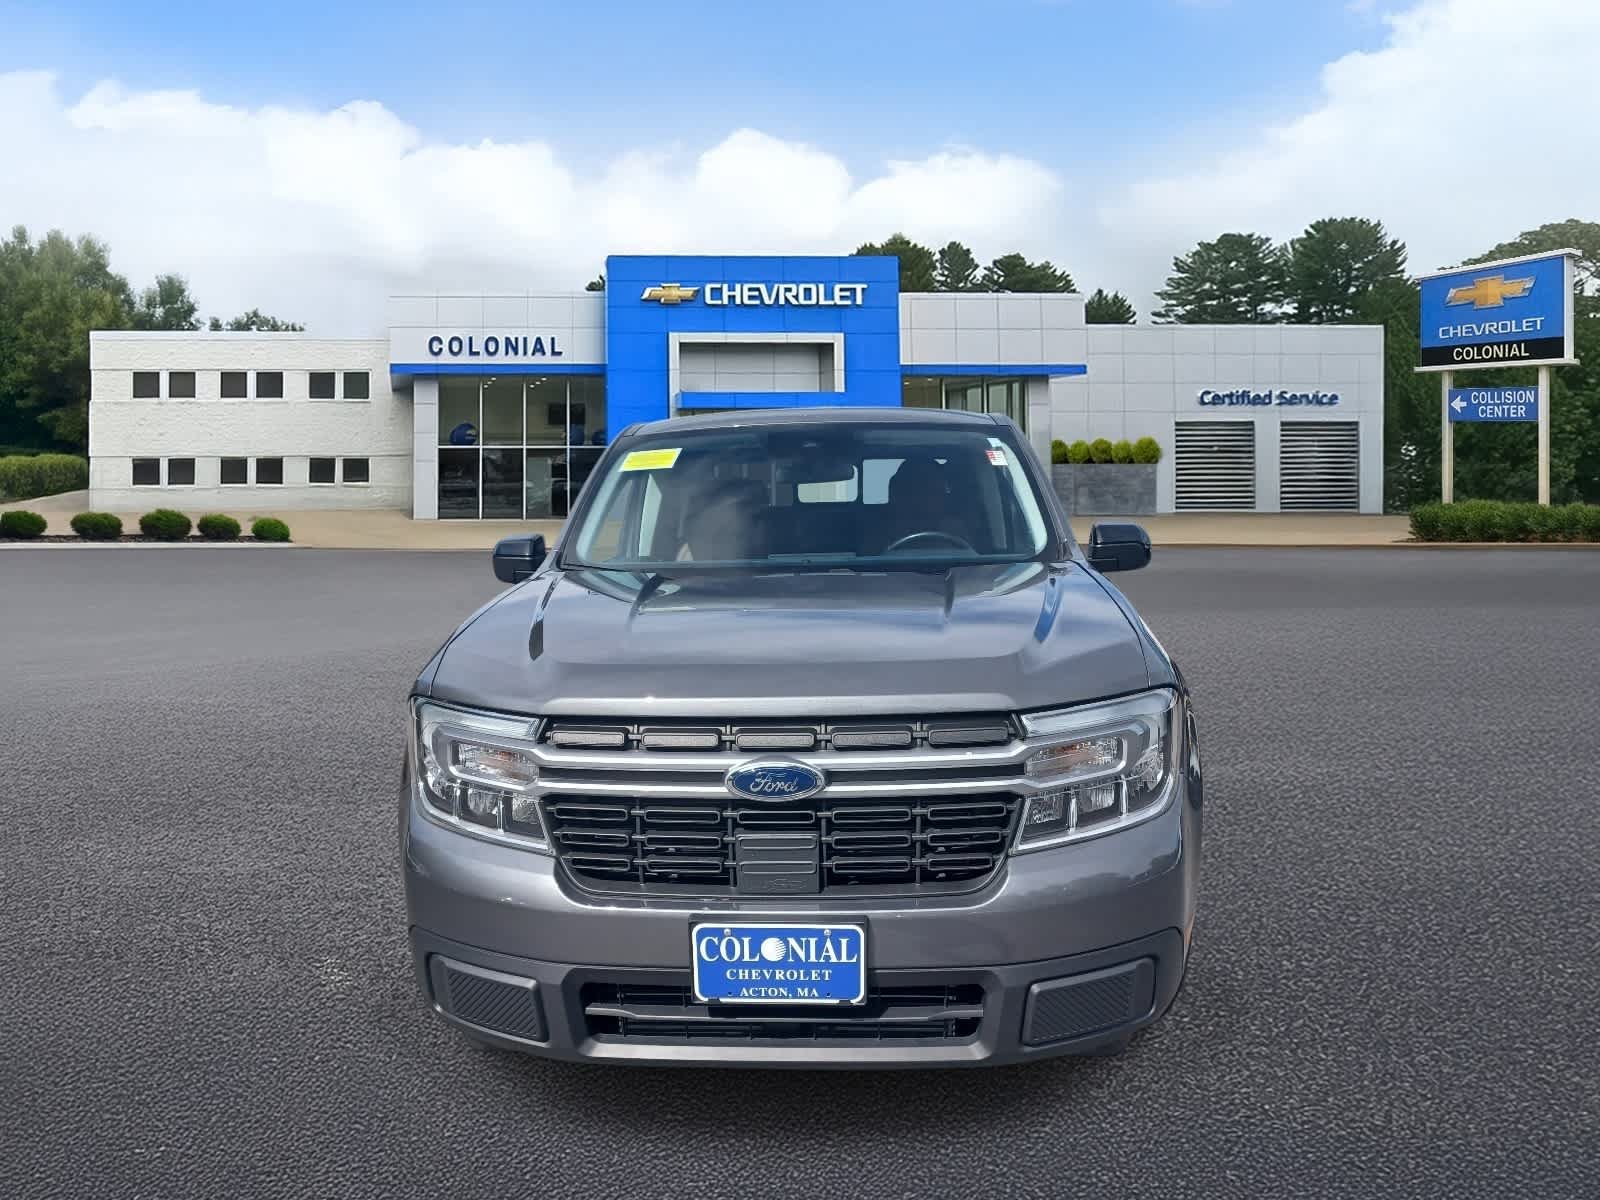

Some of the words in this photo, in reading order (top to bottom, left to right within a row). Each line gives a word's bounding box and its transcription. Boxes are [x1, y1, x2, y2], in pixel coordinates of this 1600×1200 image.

[704, 283, 868, 306] CHEVROLET
[1439, 317, 1545, 339] CHEVROLET
[428, 336, 564, 358] COLONIAL
[1453, 343, 1530, 361] COLONIAL
[1199, 390, 1273, 406] Certified
[1275, 390, 1339, 406] Service
[1471, 390, 1535, 405] COLLISION
[1478, 406, 1526, 418] CENTER
[749, 771, 800, 793] Ford
[700, 936, 858, 963] COLONIAL
[726, 969, 833, 981] CHEVROLET
[740, 987, 793, 998] ACTON,
[797, 987, 819, 998] MA
